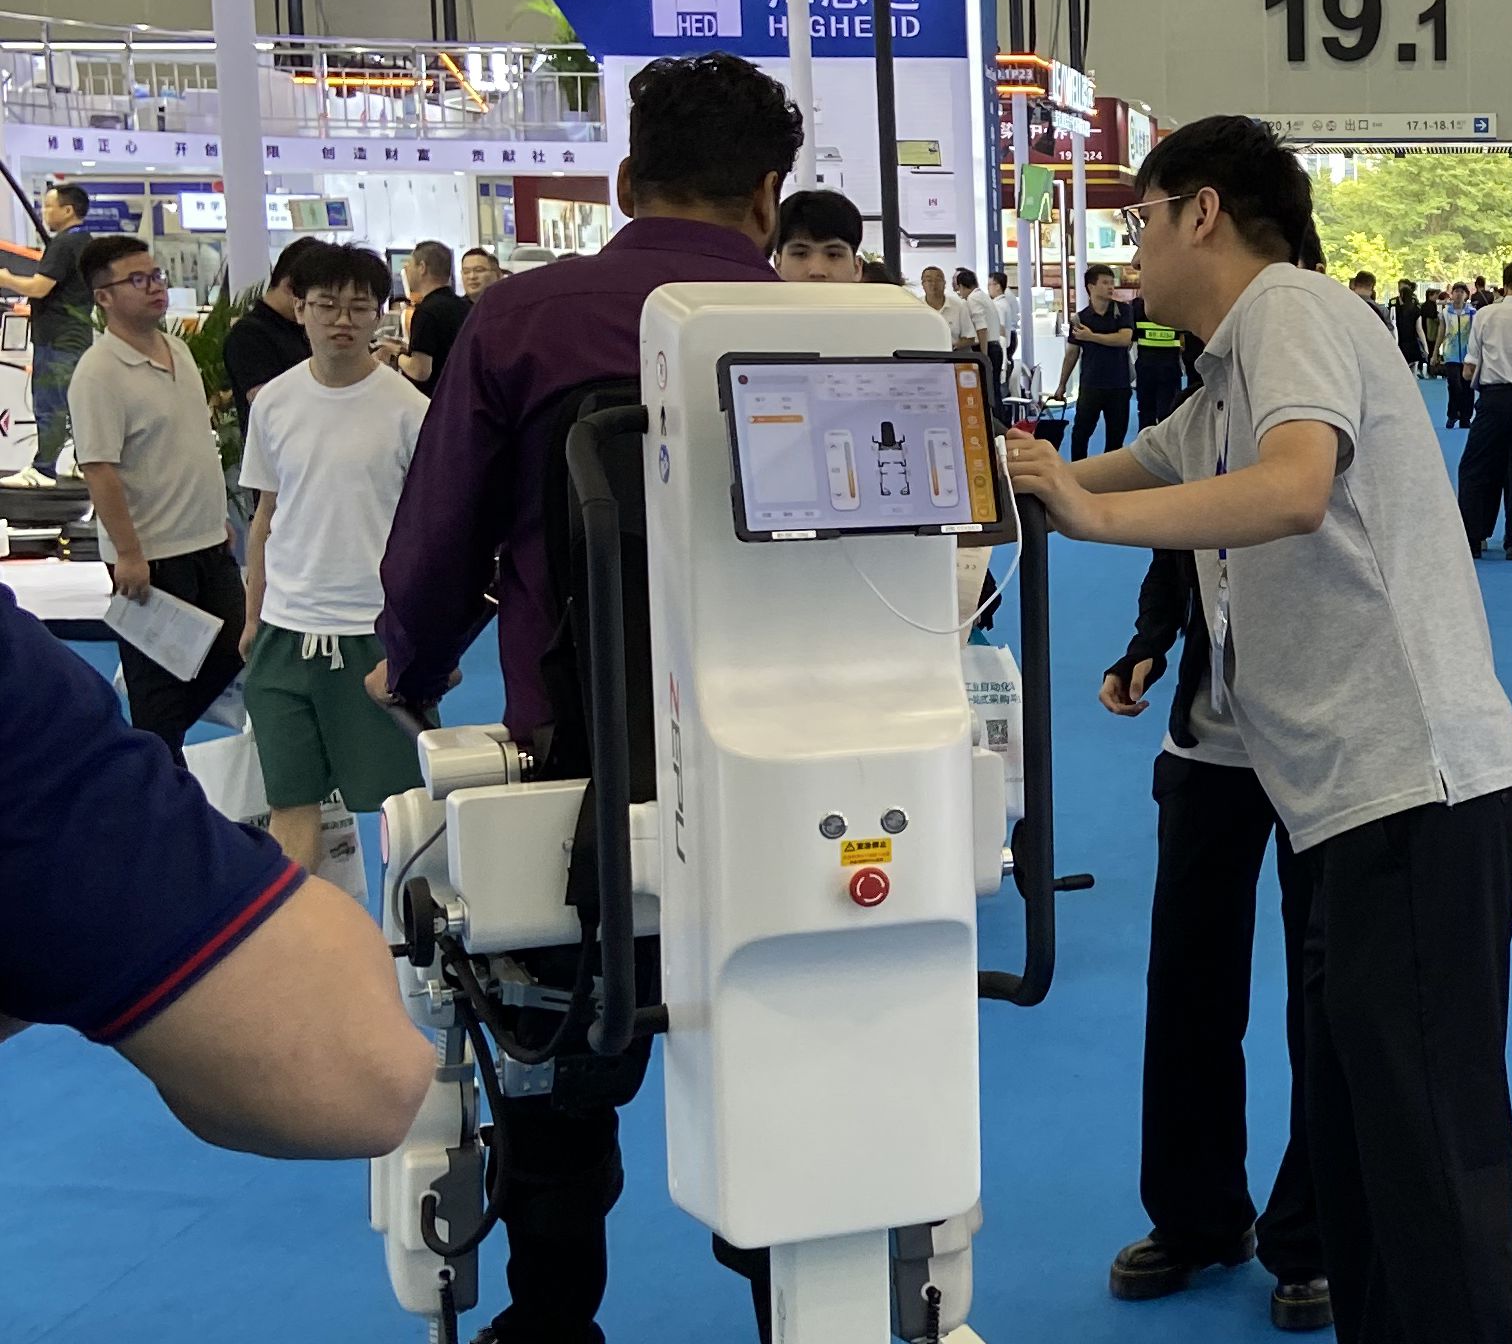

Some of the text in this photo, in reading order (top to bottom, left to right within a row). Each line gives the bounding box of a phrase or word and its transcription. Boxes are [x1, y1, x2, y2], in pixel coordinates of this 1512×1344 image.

[677, 14, 717, 37] HED
[769, 14, 921, 38] HGHED
[996, 68, 1034, 81] .1P23
[1345, 118, 1369, 131] 出口
[1406, 119, 1455, 131] 17.1-18.1
[174, 141, 281, 159] 开创限
